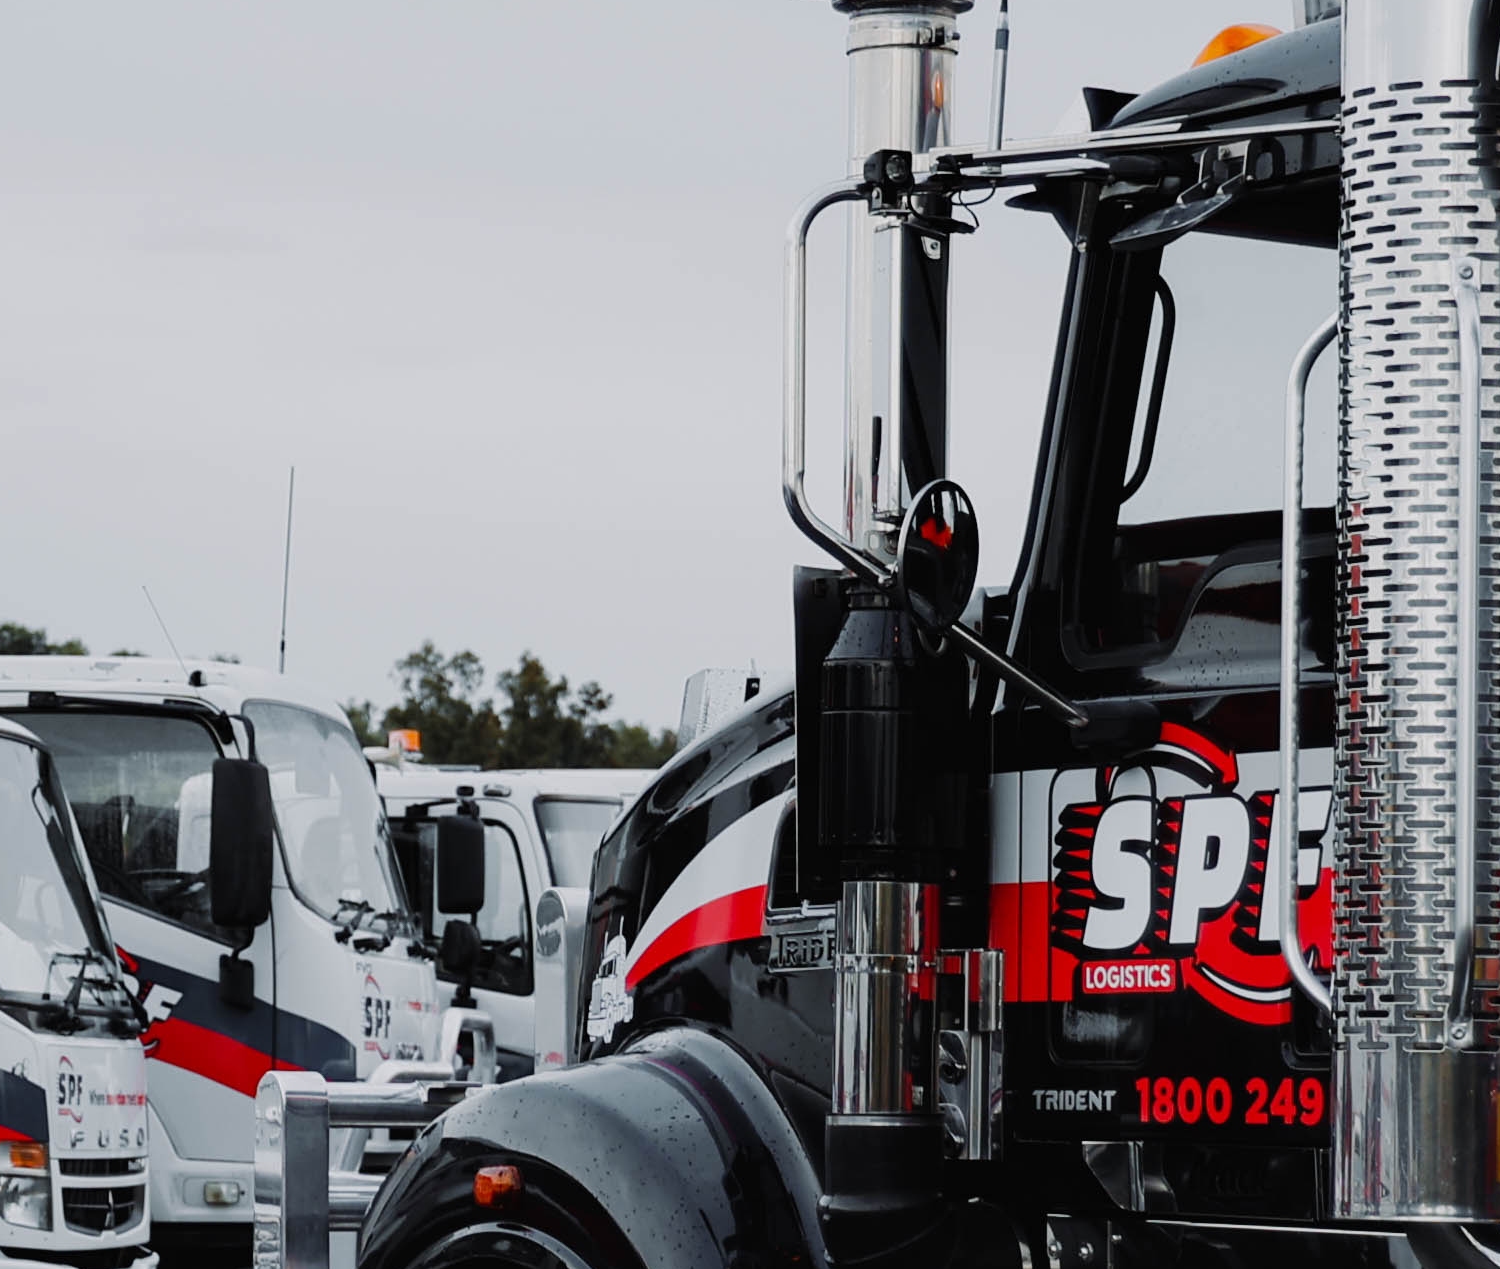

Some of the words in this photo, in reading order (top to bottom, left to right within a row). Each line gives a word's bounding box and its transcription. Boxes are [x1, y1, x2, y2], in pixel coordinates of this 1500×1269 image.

[1082, 789, 1333, 950] SPF
[1085, 964, 1172, 990] LOGISTICS
[364, 997, 391, 1039] SPF
[58, 1073, 83, 1106] SPF
[1031, 1088, 1118, 1112] TRIDENT
[1135, 1076, 1232, 1125] 1800
[1244, 1076, 1325, 1126] 249
[69, 1127, 145, 1149] FUSO
